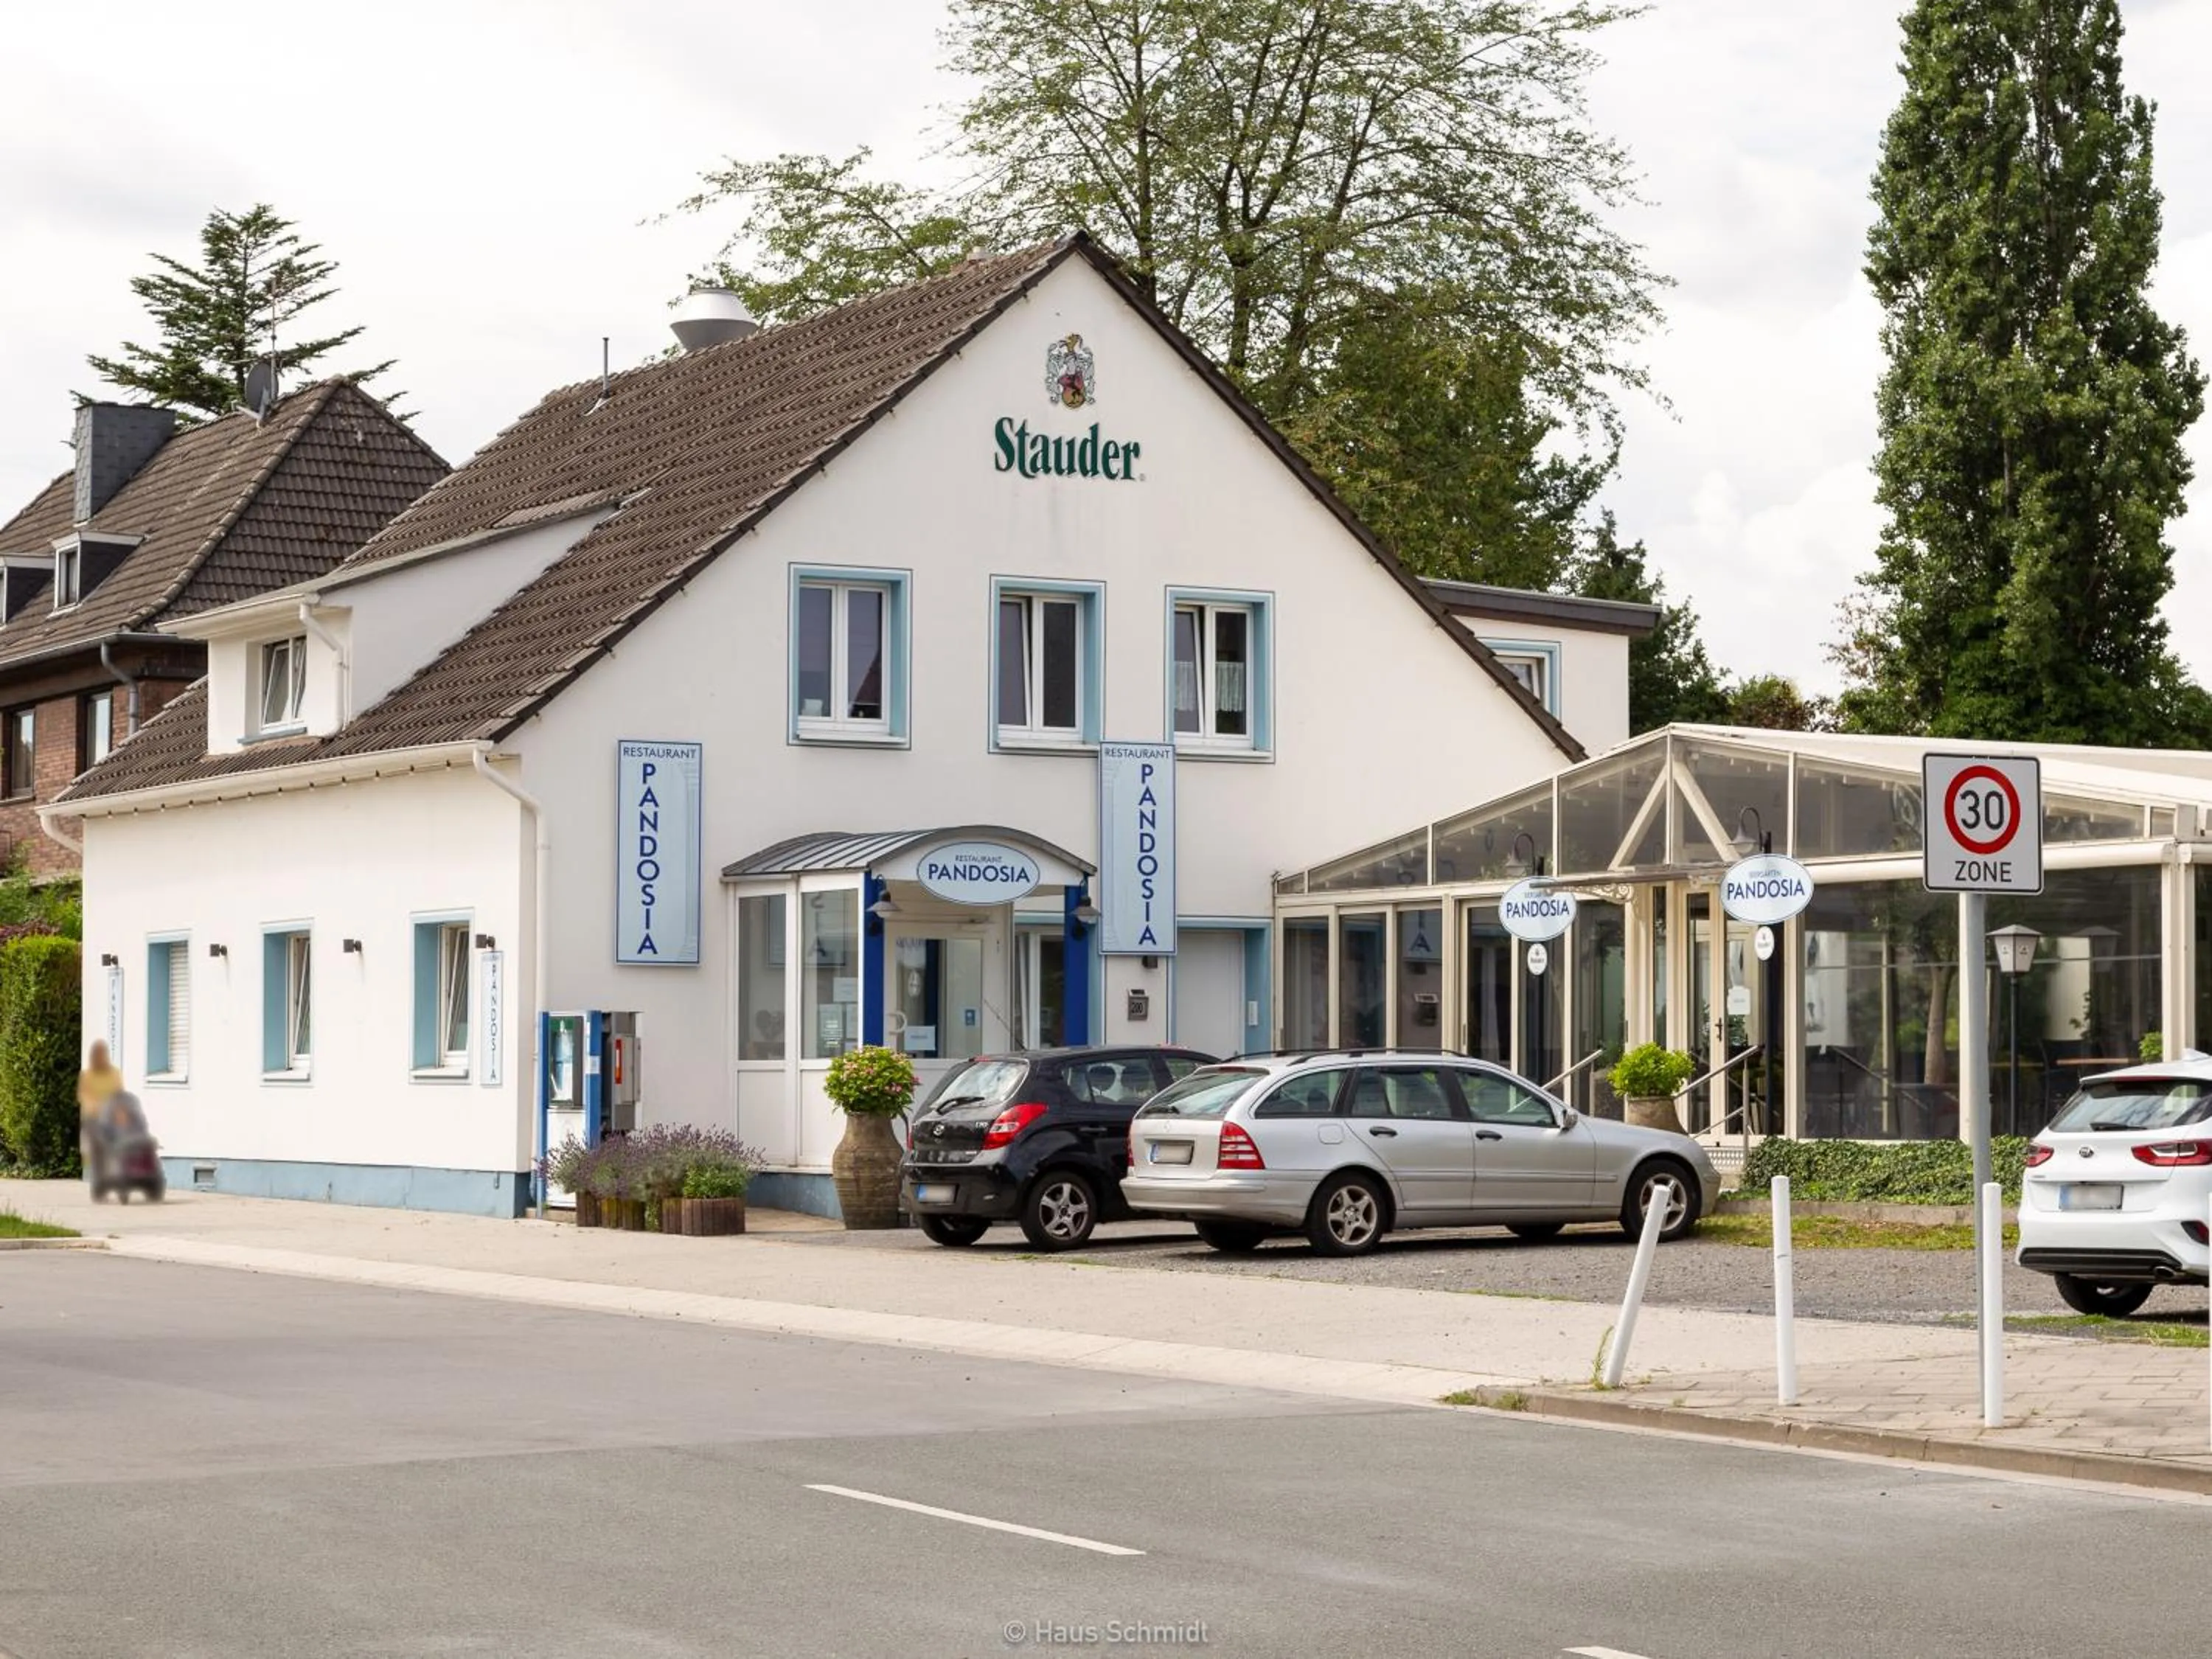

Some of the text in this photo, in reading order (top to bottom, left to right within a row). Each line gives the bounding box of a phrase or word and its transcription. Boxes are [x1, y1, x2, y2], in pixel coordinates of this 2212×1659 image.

[995, 417, 1140, 480] Stauder
[623, 747, 696, 759] RESTAURANT
[1105, 748, 1171, 759] RESTAURANT
[1960, 790, 2005, 830] 30
[637, 763, 660, 954] PANDOSIA
[1138, 764, 1158, 945] PANDOSIA
[928, 863, 1030, 883] PANDOSIA
[1955, 860, 2012, 883] ZONE
[1728, 879, 1805, 900] PANDOSIA
[1506, 900, 1570, 919] PANDOSIA
